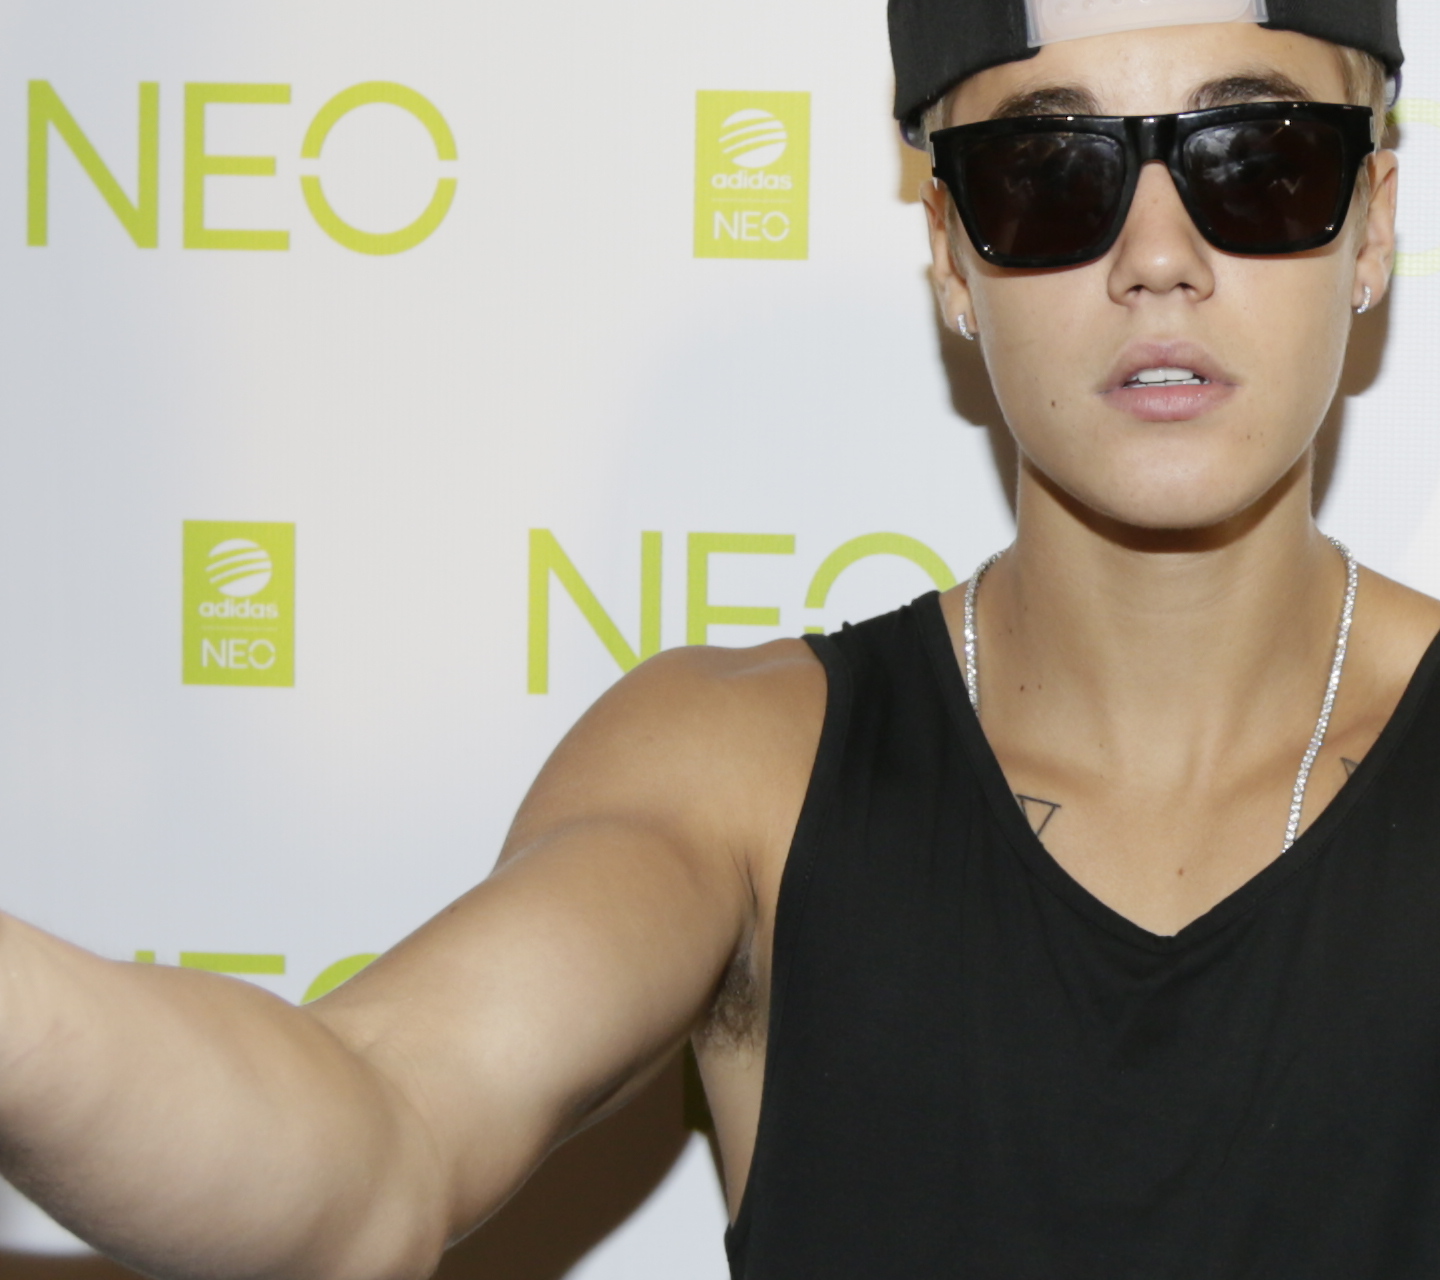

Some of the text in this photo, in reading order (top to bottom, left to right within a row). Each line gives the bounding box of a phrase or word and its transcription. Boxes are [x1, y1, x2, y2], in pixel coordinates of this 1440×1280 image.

[27, 80, 457, 255] NEO
[710, 169, 791, 189] adidas
[713, 209, 789, 241] NEO
[198, 597, 278, 618] adidas
[201, 636, 275, 669] NEO
